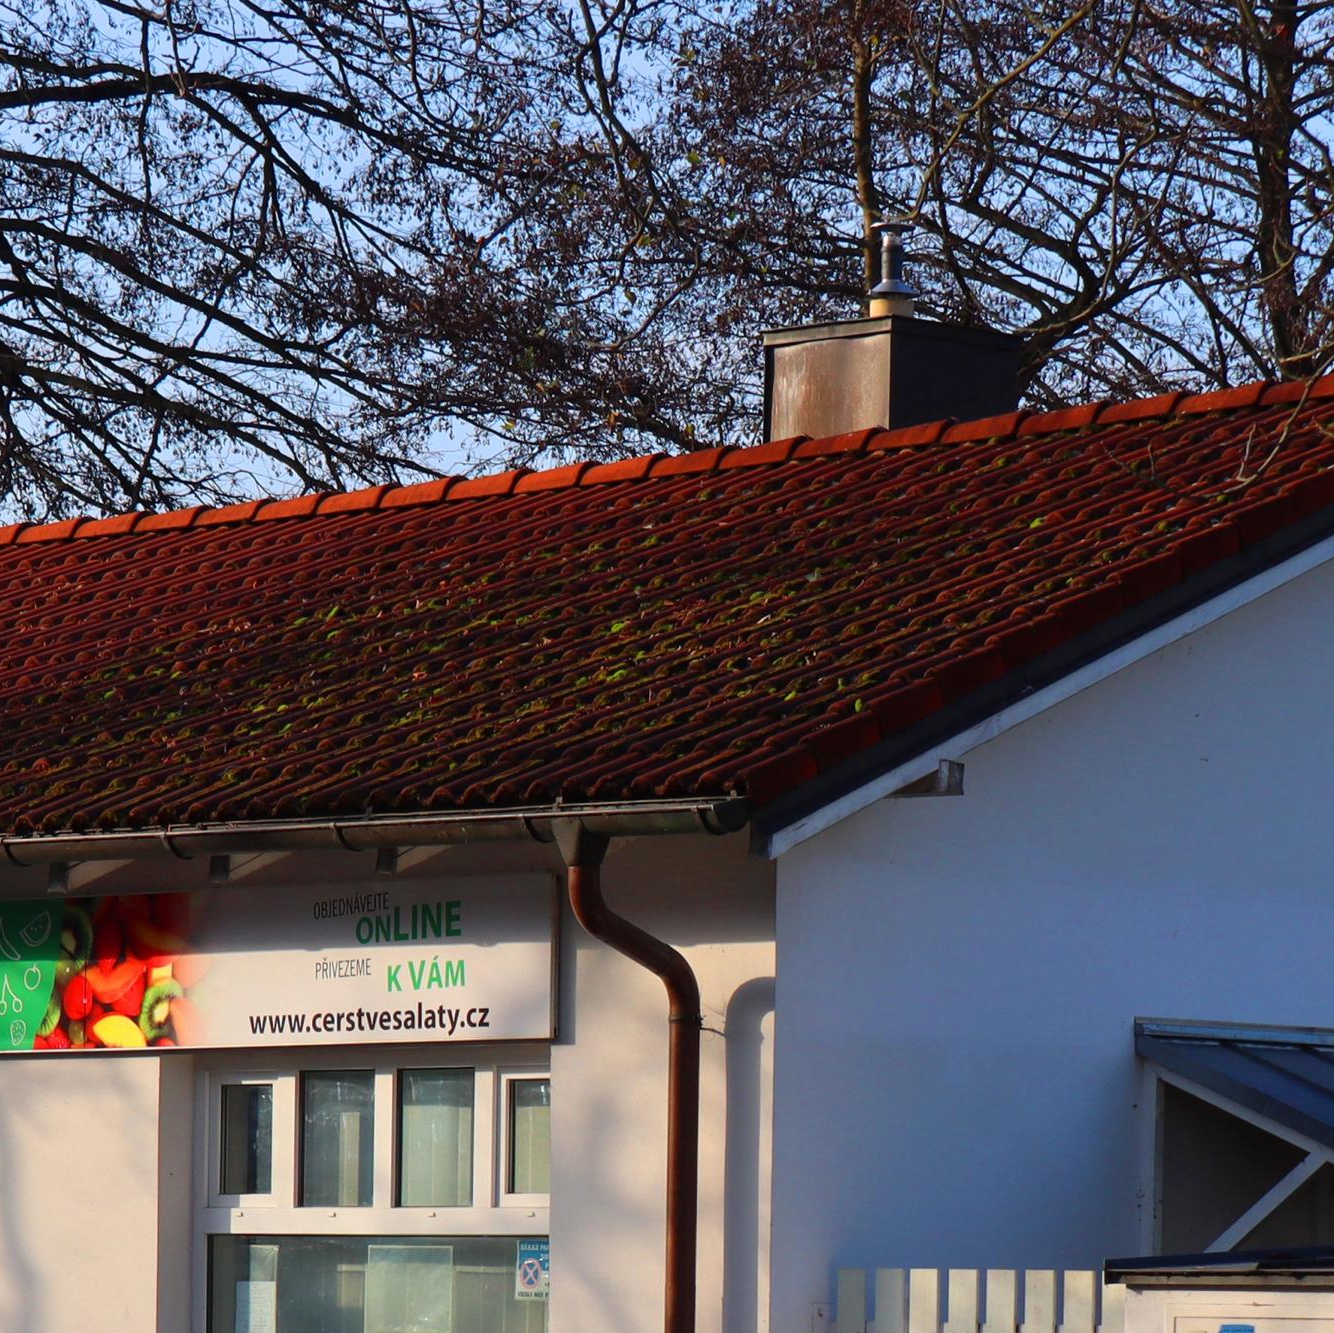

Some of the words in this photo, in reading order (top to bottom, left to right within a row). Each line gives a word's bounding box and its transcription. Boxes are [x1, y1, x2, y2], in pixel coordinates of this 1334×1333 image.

[313, 892, 390, 920] OBJEDNÁVEJTE
[355, 900, 462, 944] ONLINE
[314, 957, 372, 980] PŘIVEZEME
[387, 965, 403, 992] K
[407, 955, 466, 990] VÁM
[249, 1002, 490, 1036] www.cerstvesalaty.cz
